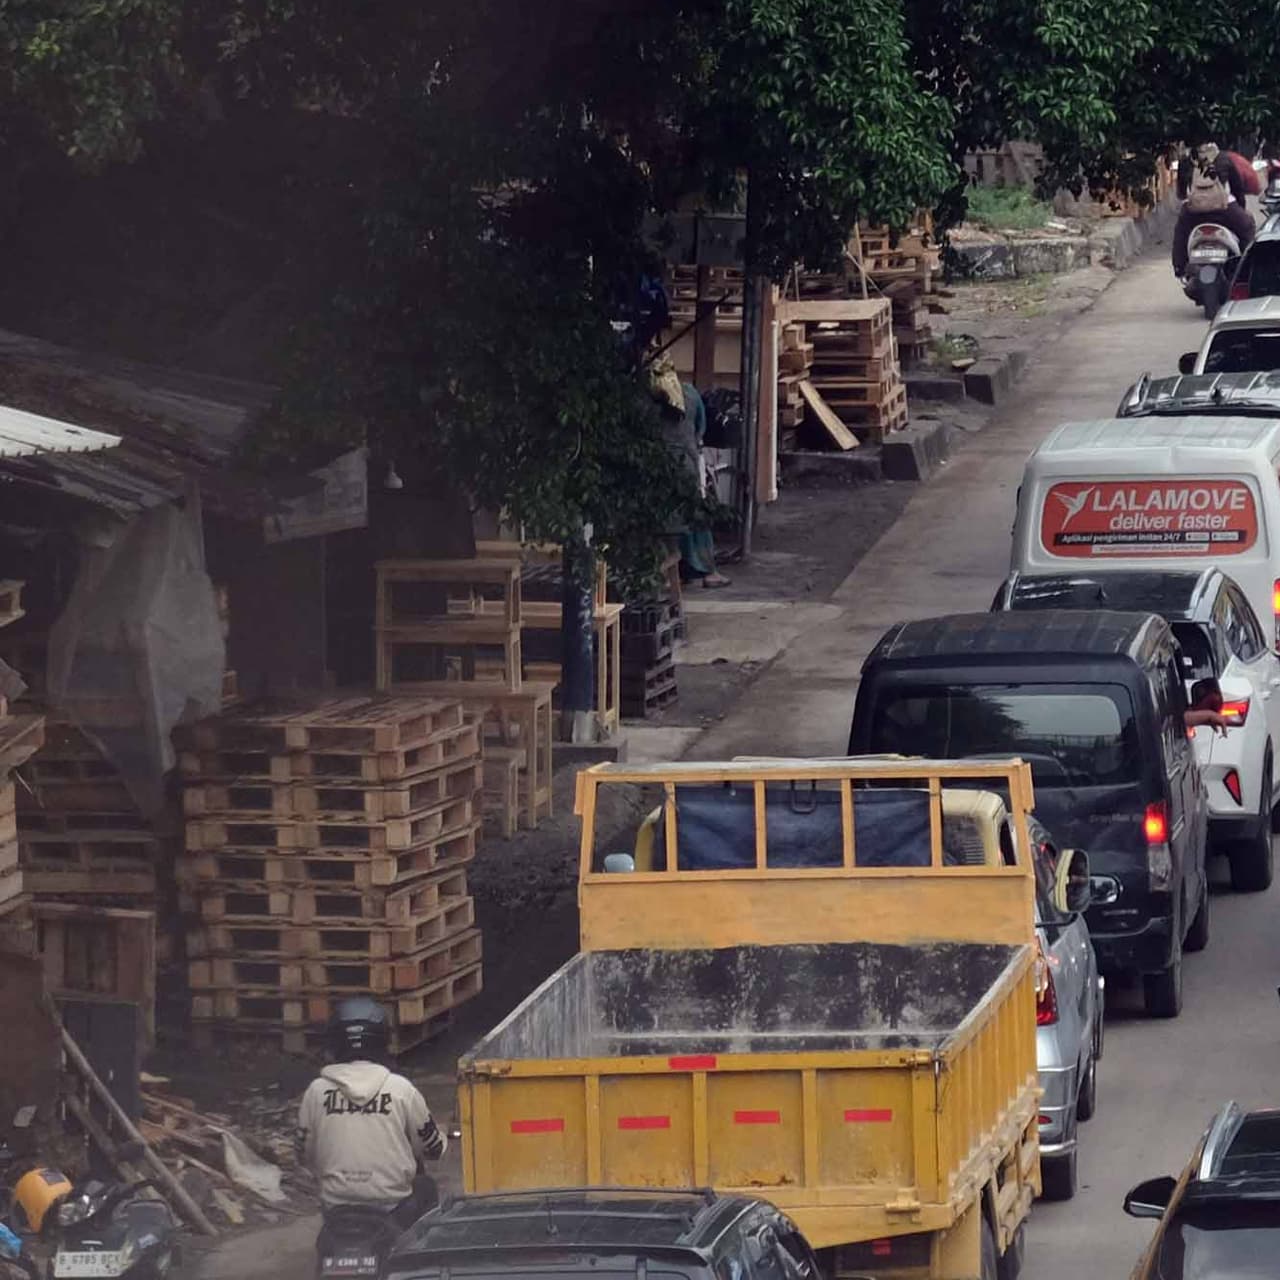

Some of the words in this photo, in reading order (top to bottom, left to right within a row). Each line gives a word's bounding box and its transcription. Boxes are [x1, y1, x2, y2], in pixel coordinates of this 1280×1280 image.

[1092, 488, 1248, 512] LALAMOVE
[1109, 512, 1172, 530] deliver
[1178, 511, 1231, 529] faster
